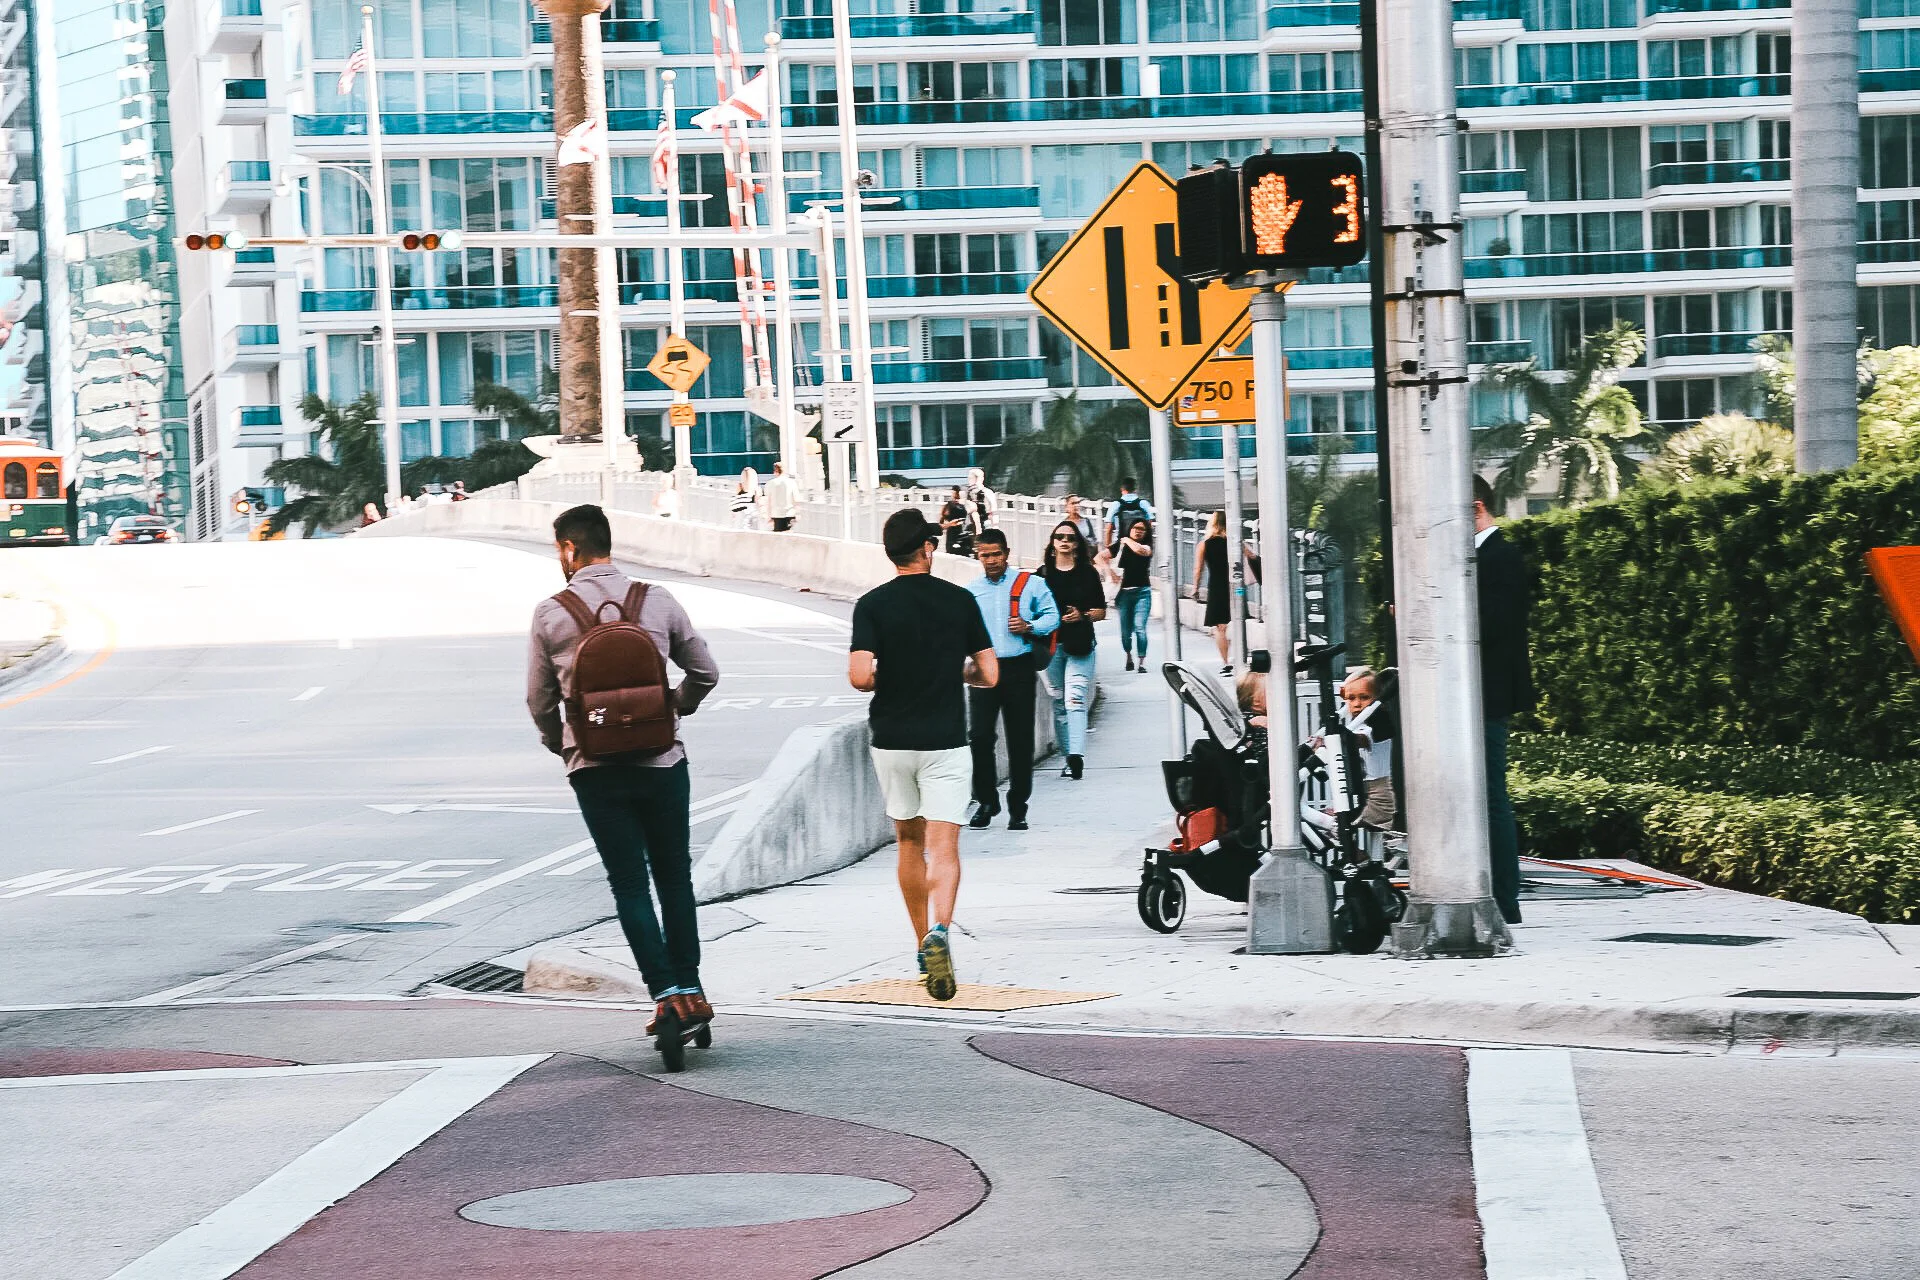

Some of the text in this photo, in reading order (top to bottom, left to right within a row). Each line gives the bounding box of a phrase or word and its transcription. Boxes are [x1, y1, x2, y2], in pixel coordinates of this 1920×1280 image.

[1330, 174, 1358, 242] 3
[1190, 379, 1255, 401] 750 F
[700, 694, 872, 712] RGE
